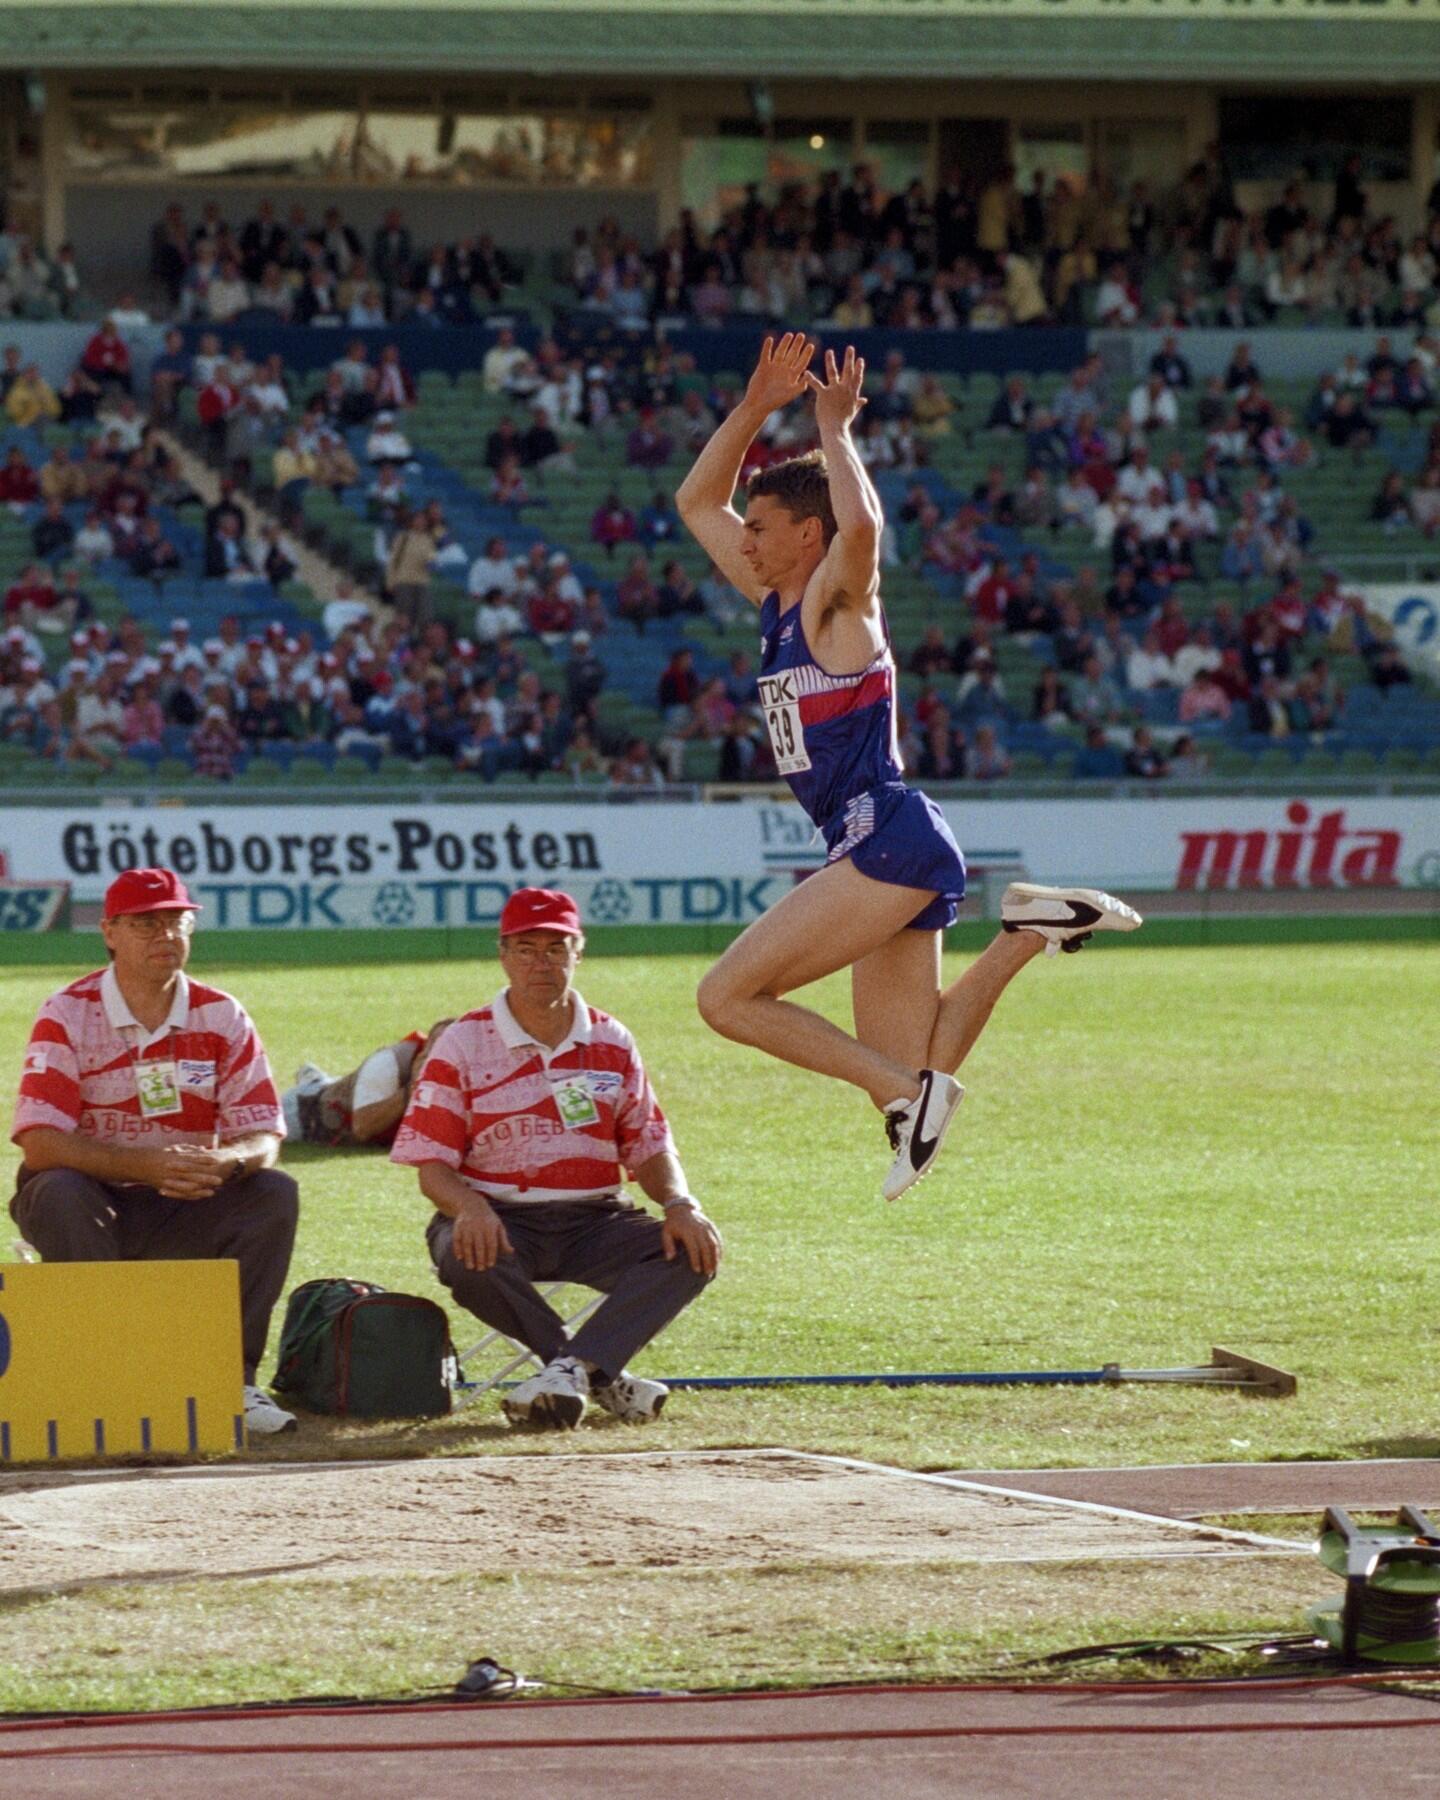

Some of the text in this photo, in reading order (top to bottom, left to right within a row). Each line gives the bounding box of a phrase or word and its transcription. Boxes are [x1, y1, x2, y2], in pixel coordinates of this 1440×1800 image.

[759, 676, 796, 706] TDK
[769, 707, 795, 758] 39
[62, 816, 601, 878] Göteborgs-Posten
[1176, 800, 1403, 891] mita
[196, 882, 344, 925] TDK
[633, 877, 774, 919] TDK
